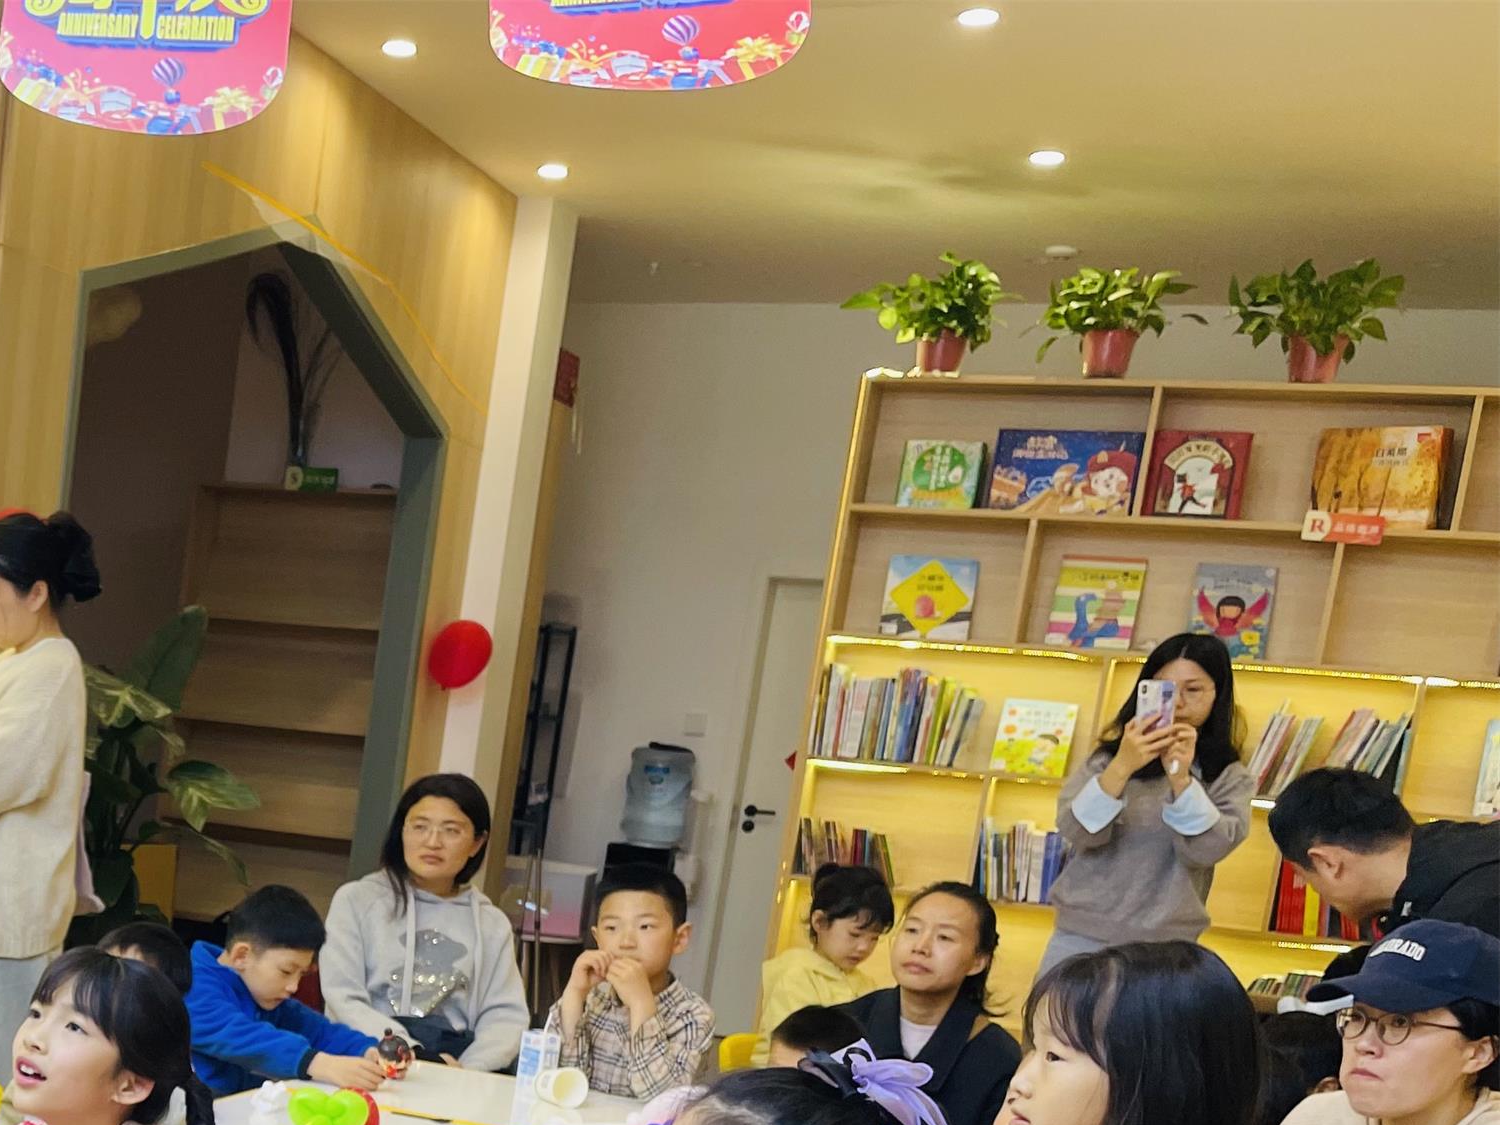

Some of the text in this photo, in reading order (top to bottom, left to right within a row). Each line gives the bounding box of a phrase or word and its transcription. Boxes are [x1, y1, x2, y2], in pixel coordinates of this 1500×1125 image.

[57, 12, 235, 41] ANNIVERSARY CELEBRATION
[1310, 519, 1325, 533] R
